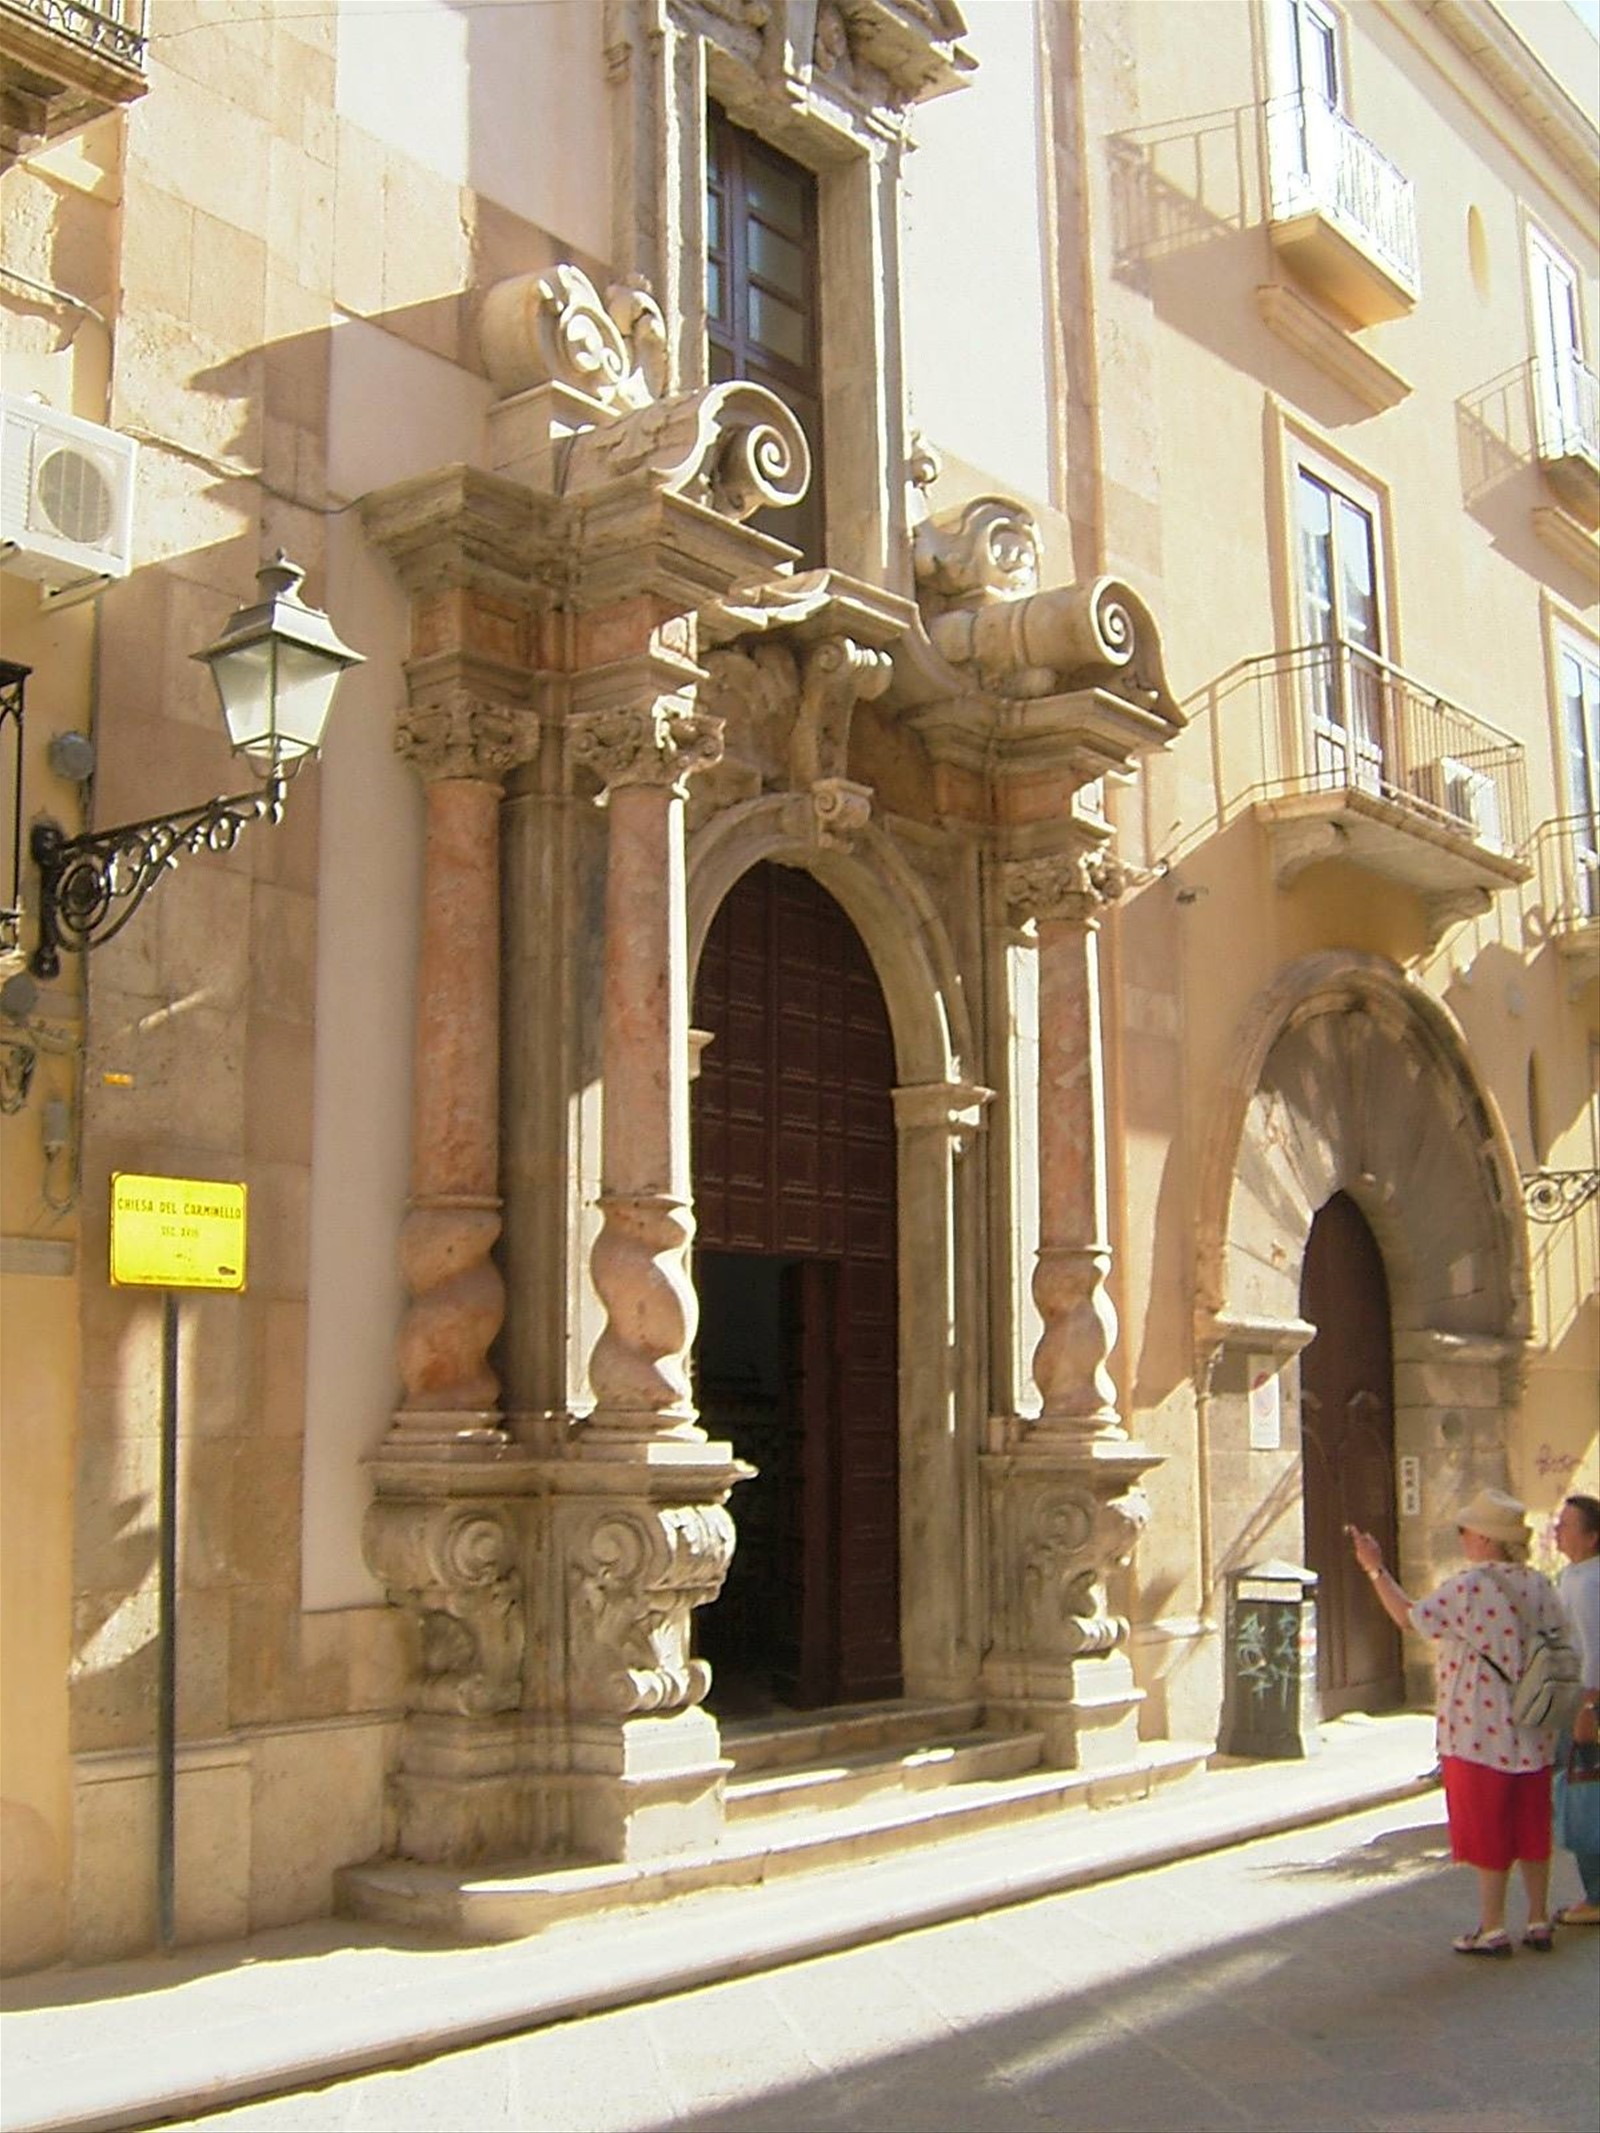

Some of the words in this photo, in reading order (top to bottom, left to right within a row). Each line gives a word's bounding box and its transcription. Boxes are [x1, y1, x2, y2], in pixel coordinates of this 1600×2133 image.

[118, 1198, 153, 1213] CHIESA
[160, 1202, 177, 1215] DEL
[184, 1203, 241, 1219] CARMINELLO
